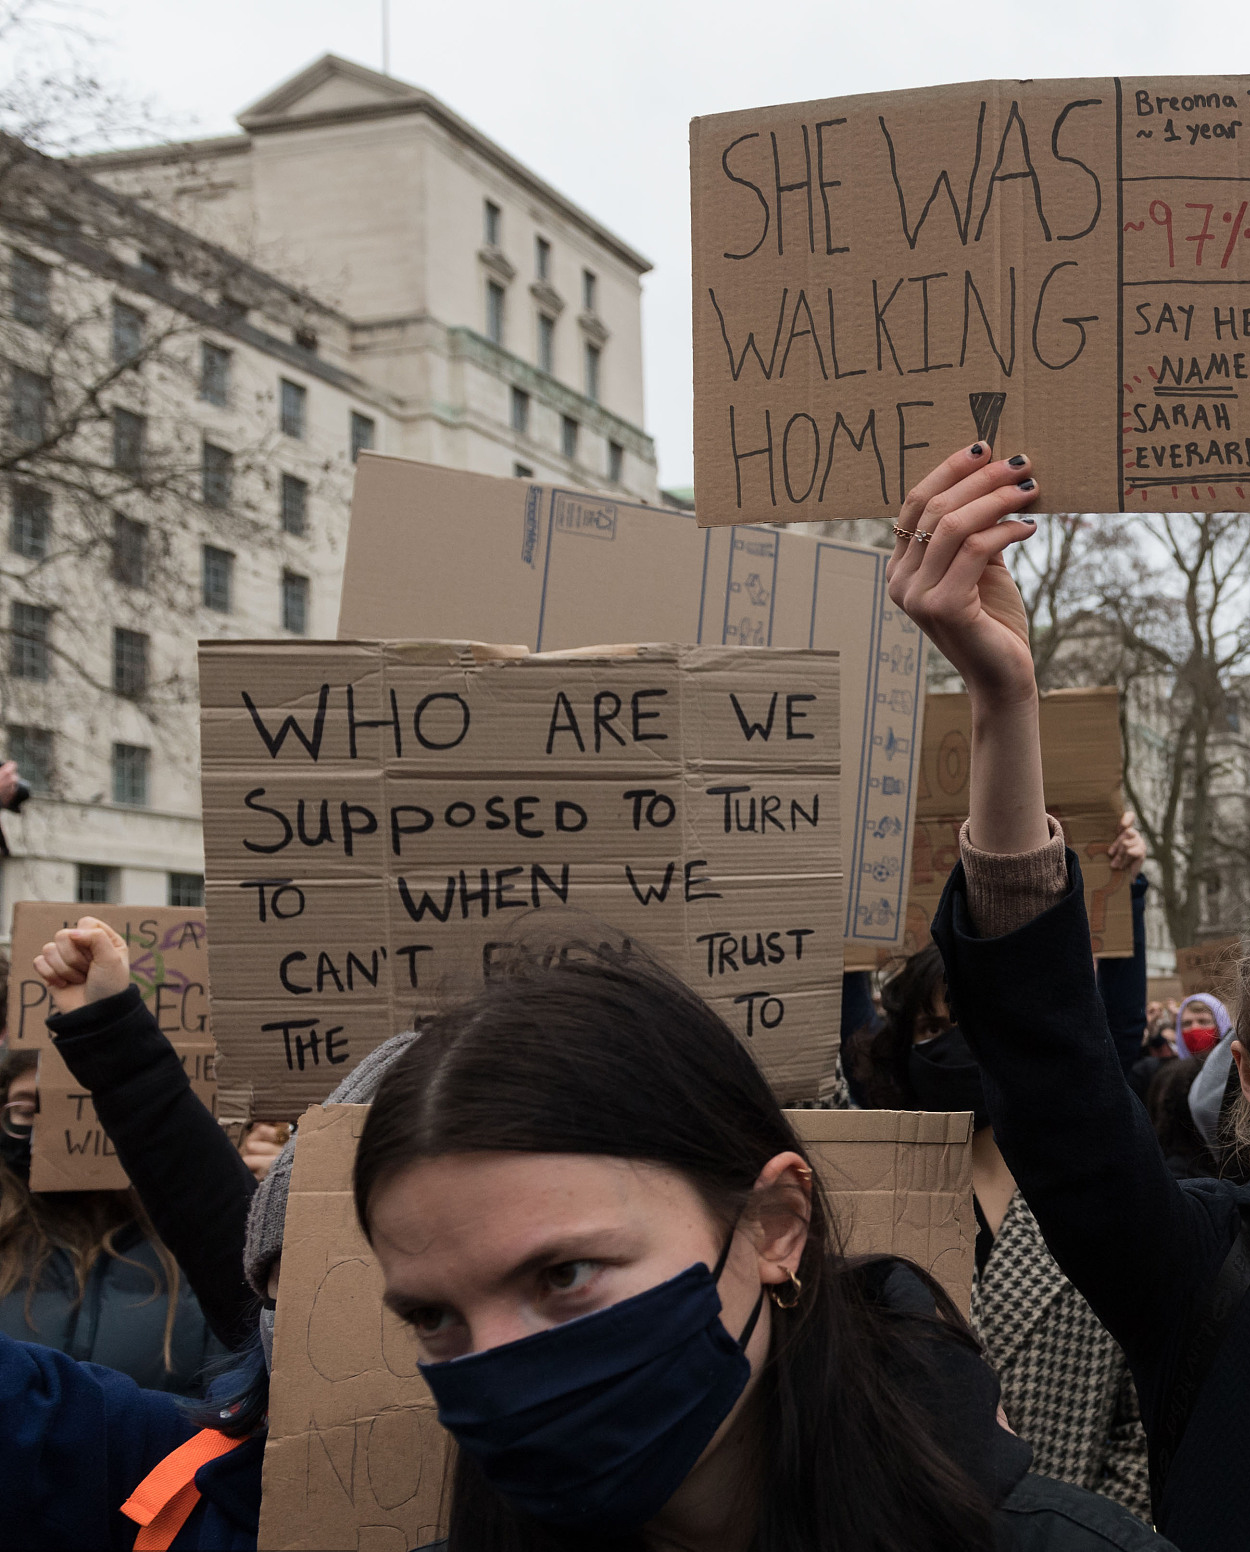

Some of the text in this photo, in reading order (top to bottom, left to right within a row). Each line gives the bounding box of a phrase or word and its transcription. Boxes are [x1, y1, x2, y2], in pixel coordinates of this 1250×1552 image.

[1135, 89, 1238, 117] Breonna
[1186, 120, 1243, 146] year
[722, 99, 1102, 260] SHE WAS
[709, 260, 1100, 382] WALKING
[1134, 302, 1195, 341] SAY
[1133, 402, 1231, 433] SARAH
[241, 683, 816, 762] WHO ARE WE
[623, 788, 677, 832] TO
[705, 784, 820, 836] TURN
[240, 859, 724, 924] TO WHEN WE
[178, 920, 201, 950] A
[279, 945, 435, 995] CAN'T
[696, 929, 815, 978] TRUST
[261, 1018, 350, 1071] THE
[733, 992, 785, 1038] TO
